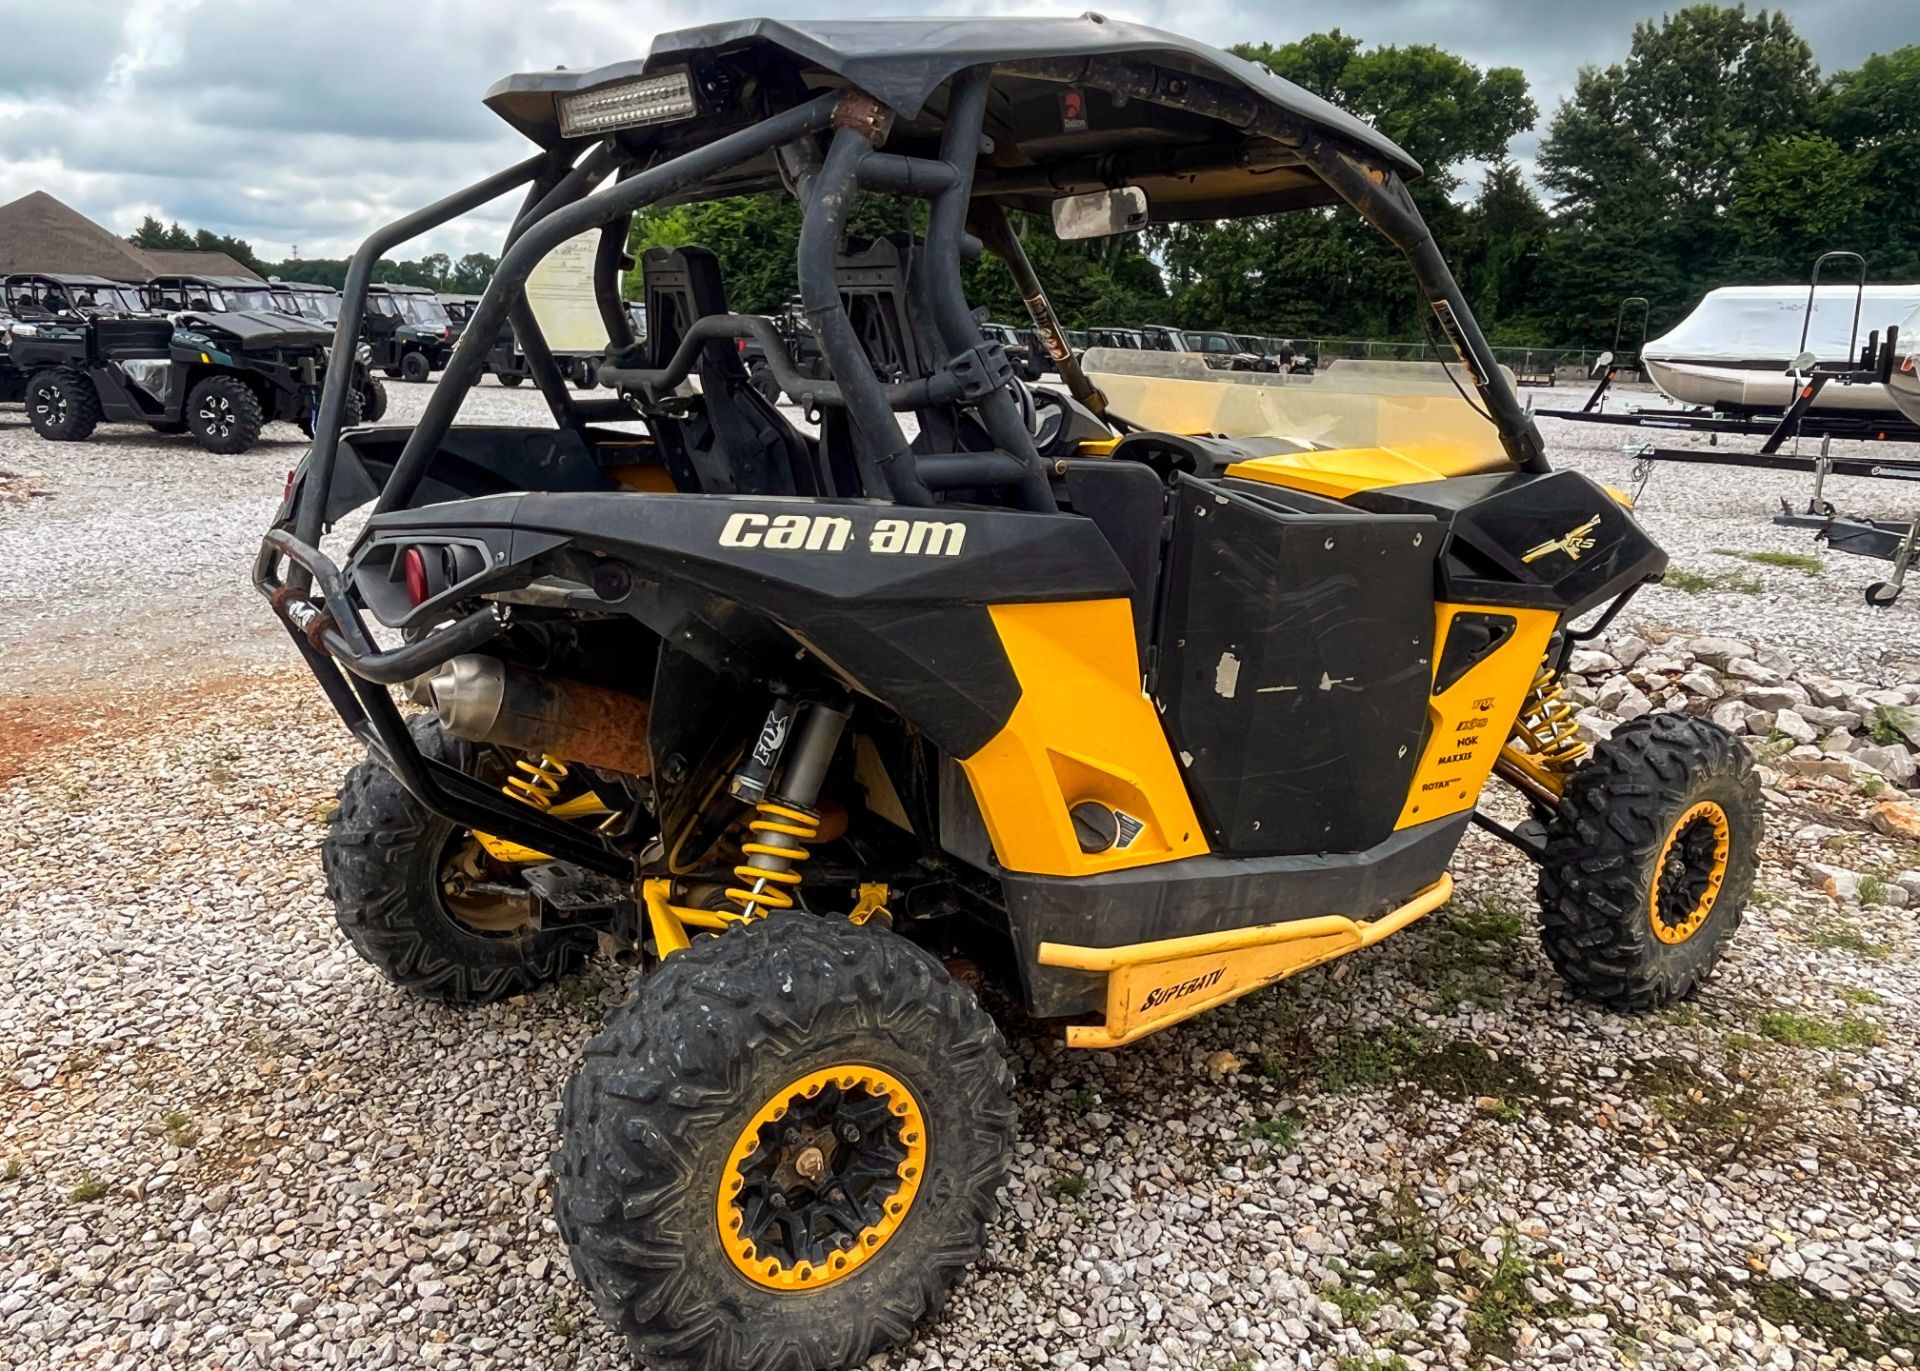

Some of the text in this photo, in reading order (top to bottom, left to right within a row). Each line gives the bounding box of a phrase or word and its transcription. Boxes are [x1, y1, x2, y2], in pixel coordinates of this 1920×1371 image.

[718, 512, 968, 557] can am
[752, 709, 789, 767] FOX
[1456, 735, 1479, 748] NGK
[1437, 751, 1473, 765] MAXXIS
[1421, 780, 1451, 792] ROTAX
[1139, 966, 1228, 1012] SUPERATV
